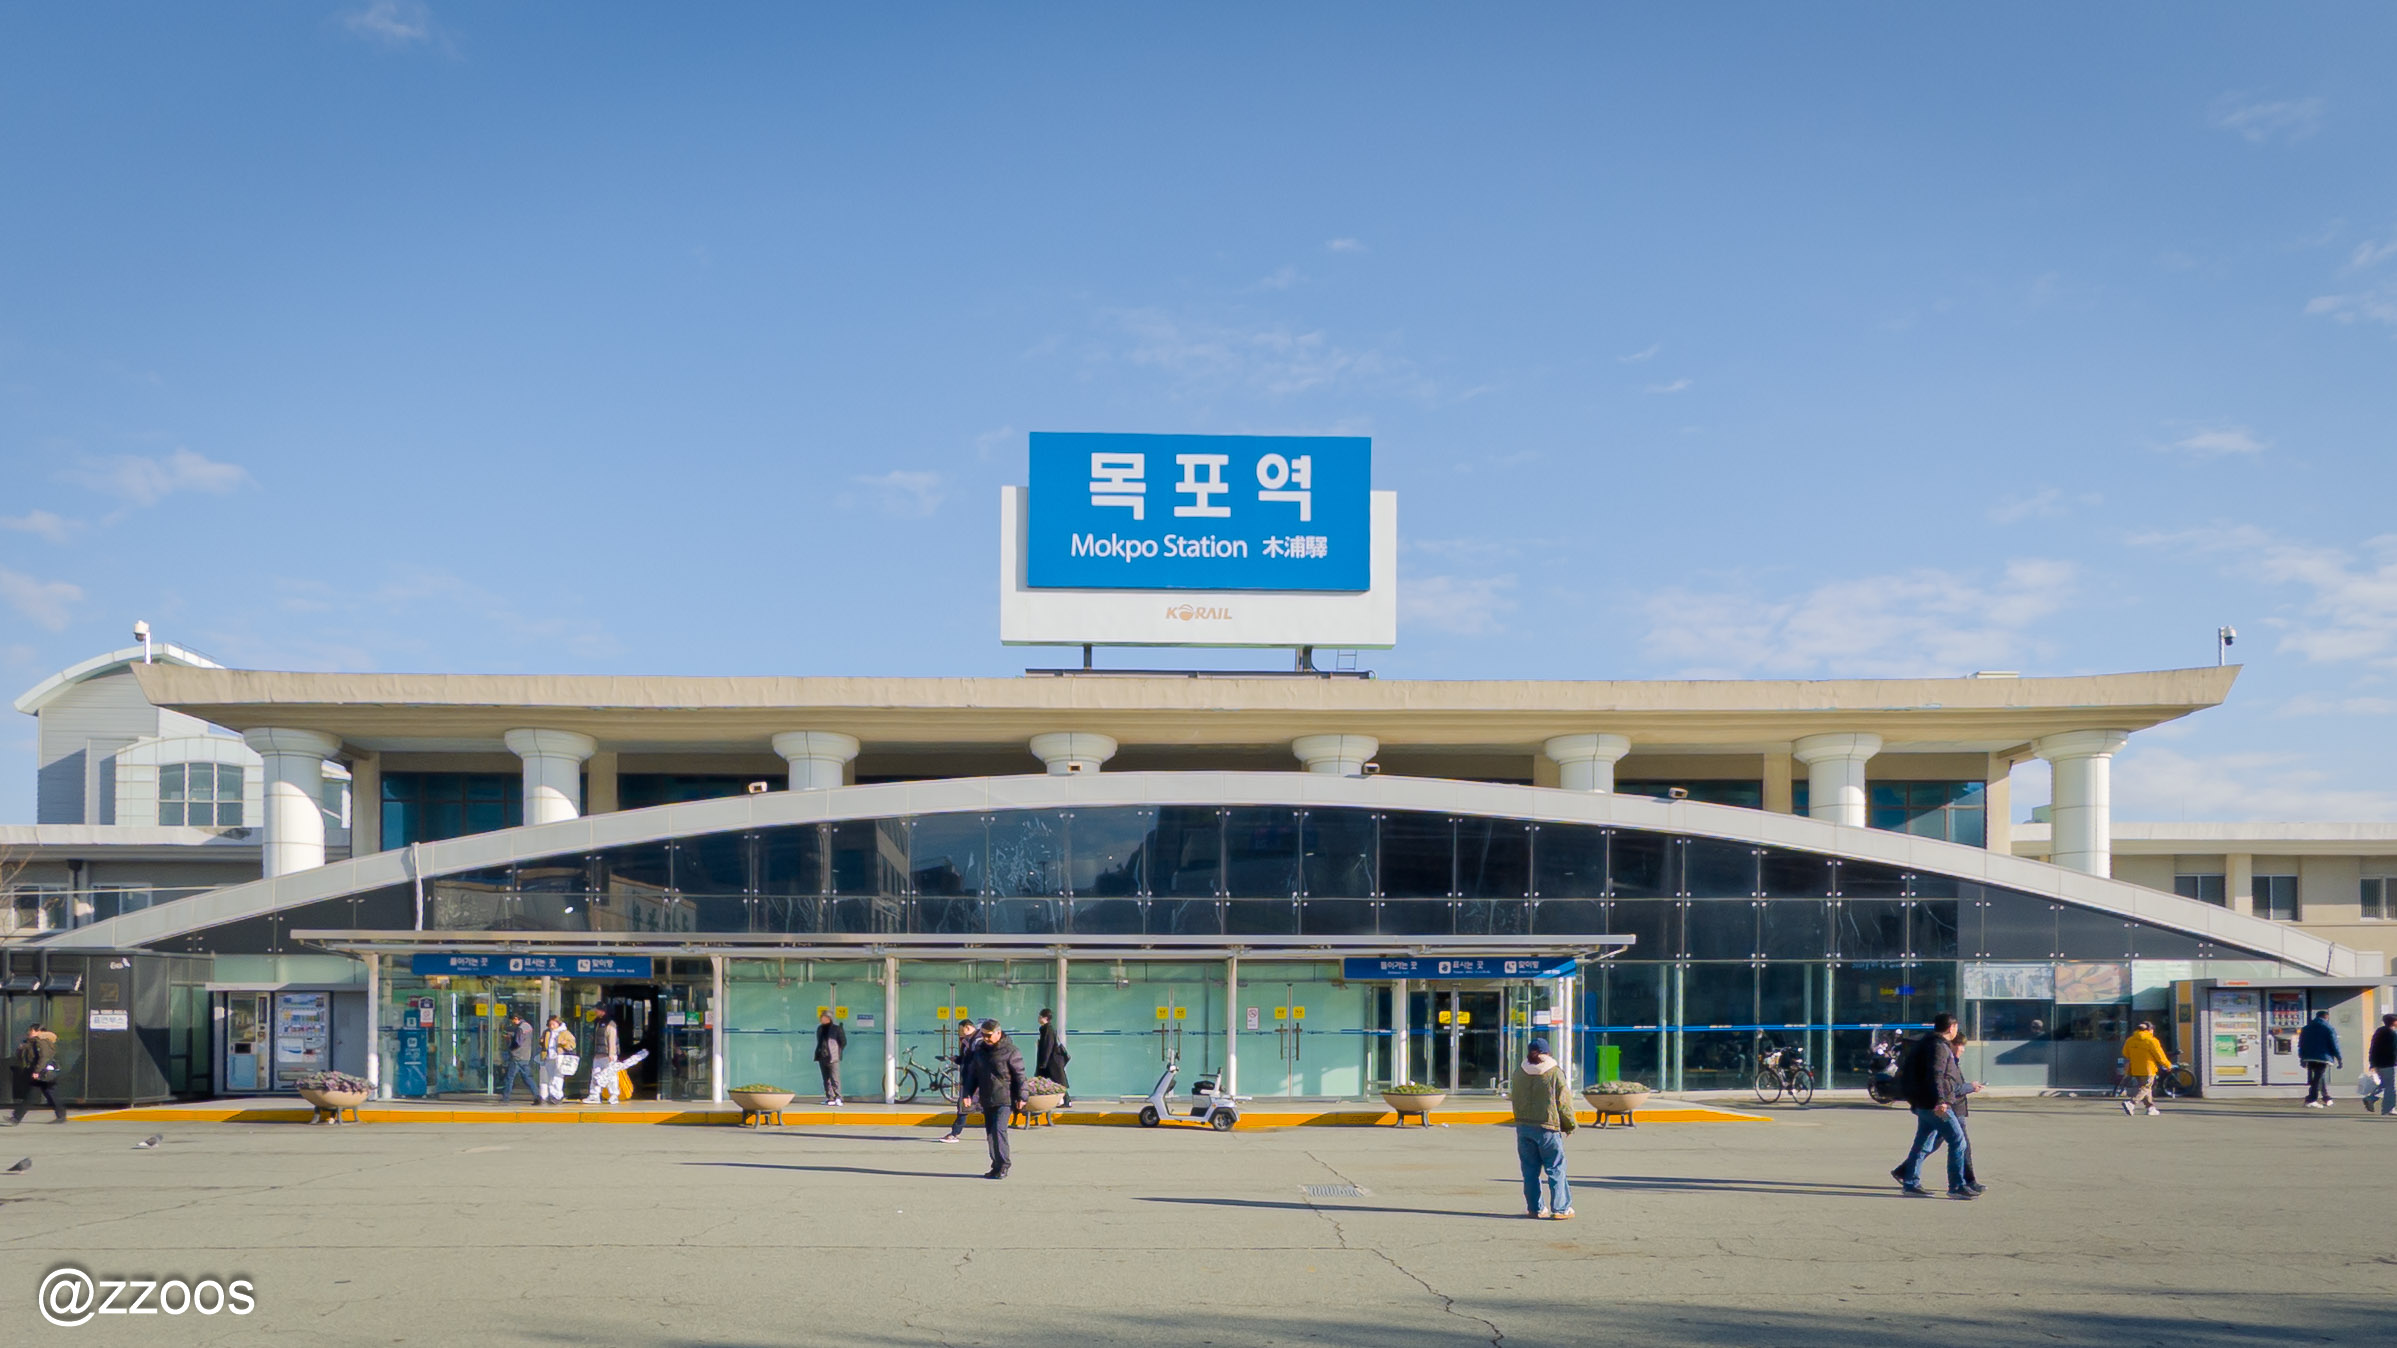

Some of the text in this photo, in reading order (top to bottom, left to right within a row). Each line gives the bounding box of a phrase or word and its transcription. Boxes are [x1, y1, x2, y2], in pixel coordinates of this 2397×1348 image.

[1071, 533, 1248, 562] Mokpo Station
[1262, 536, 1328, 559] 木浦驛
[1165, 604, 1233, 621] KORAIL
